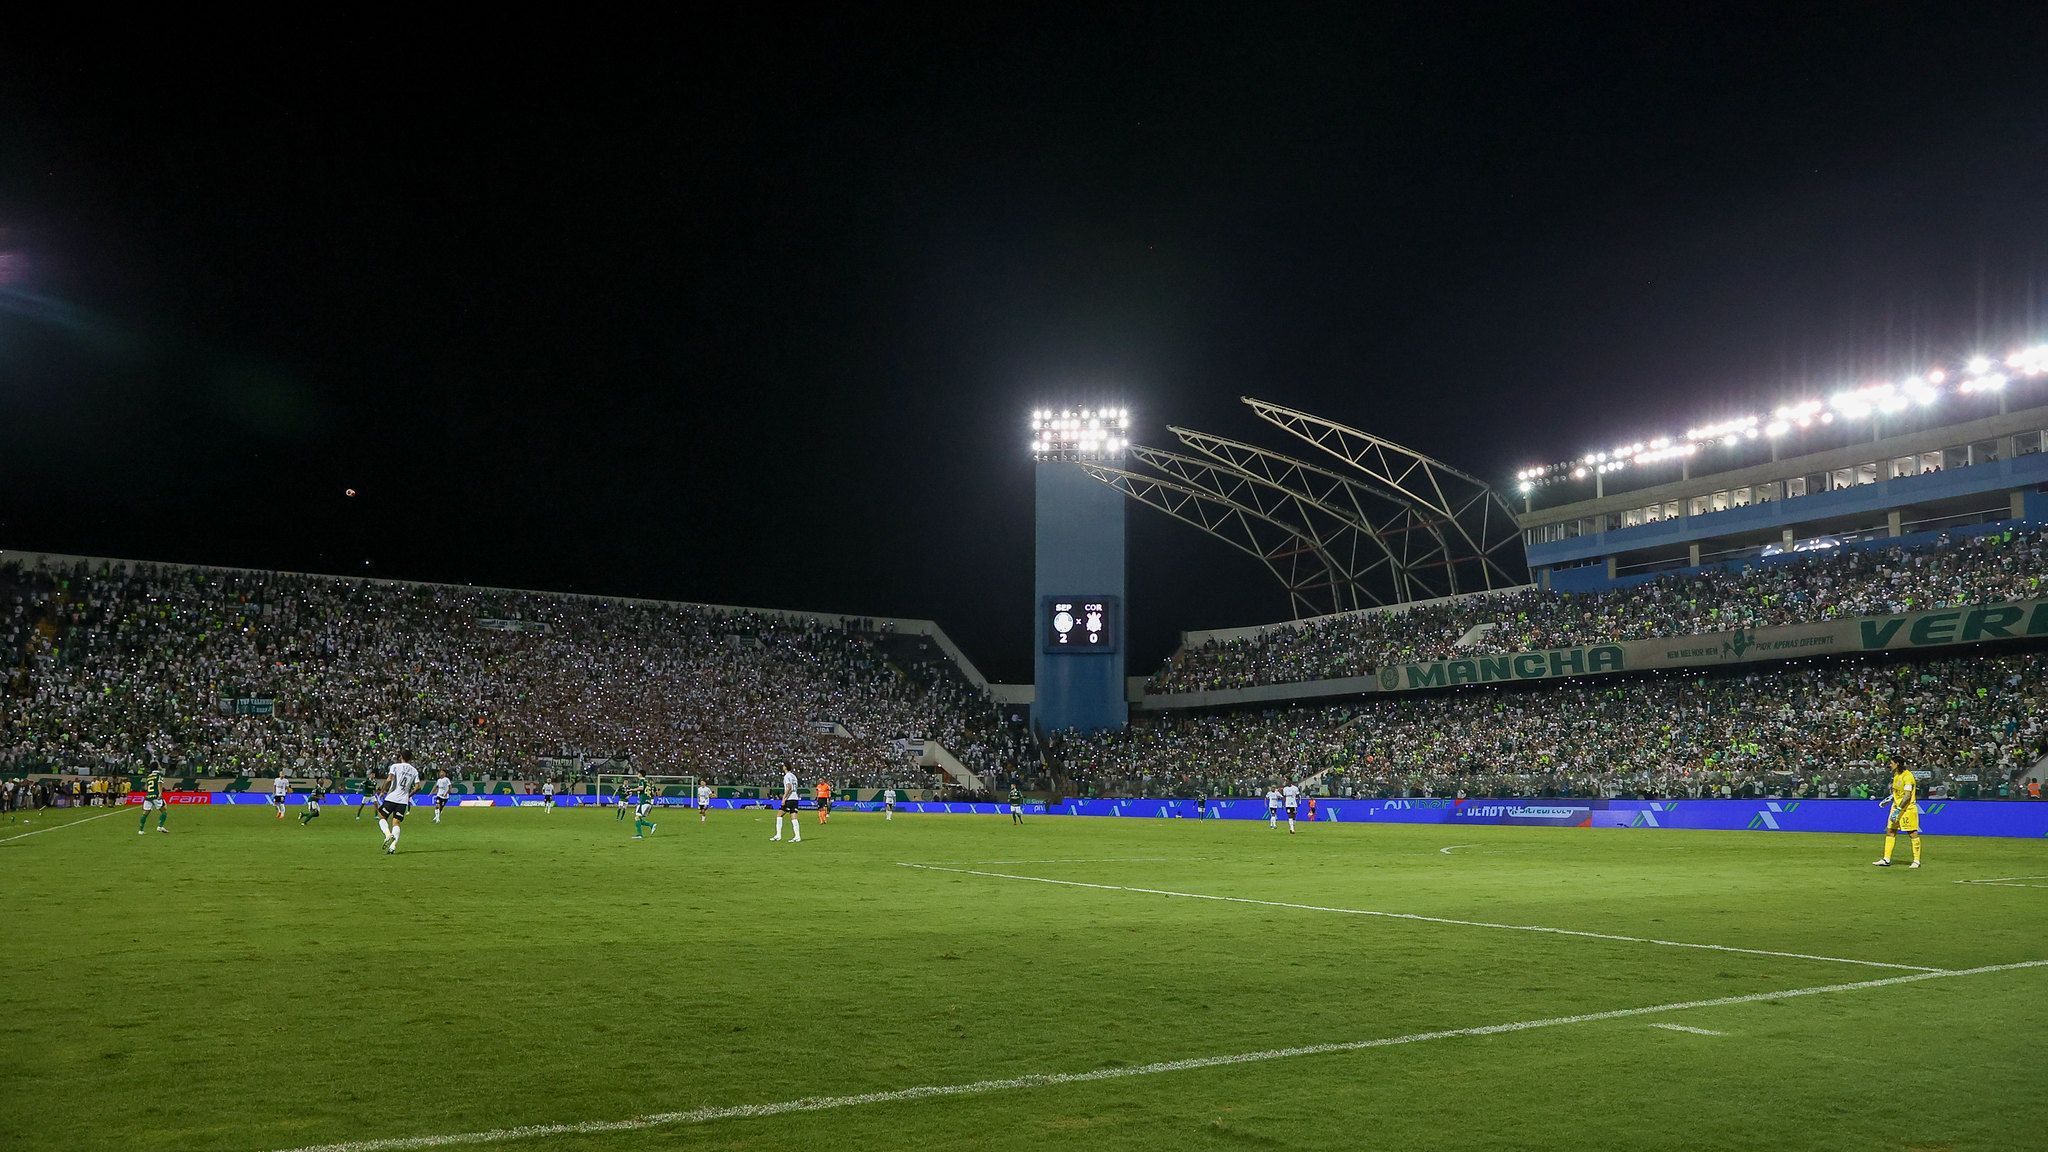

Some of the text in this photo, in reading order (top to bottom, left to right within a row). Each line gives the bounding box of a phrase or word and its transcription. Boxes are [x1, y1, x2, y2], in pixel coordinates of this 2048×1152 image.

[1059, 633, 1068, 643] 2
[1089, 633, 1098, 643] 0
[1773, 639, 1799, 650] APENAS
[1405, 645, 1625, 689] MANCHA
[147, 780, 155, 792] 2
